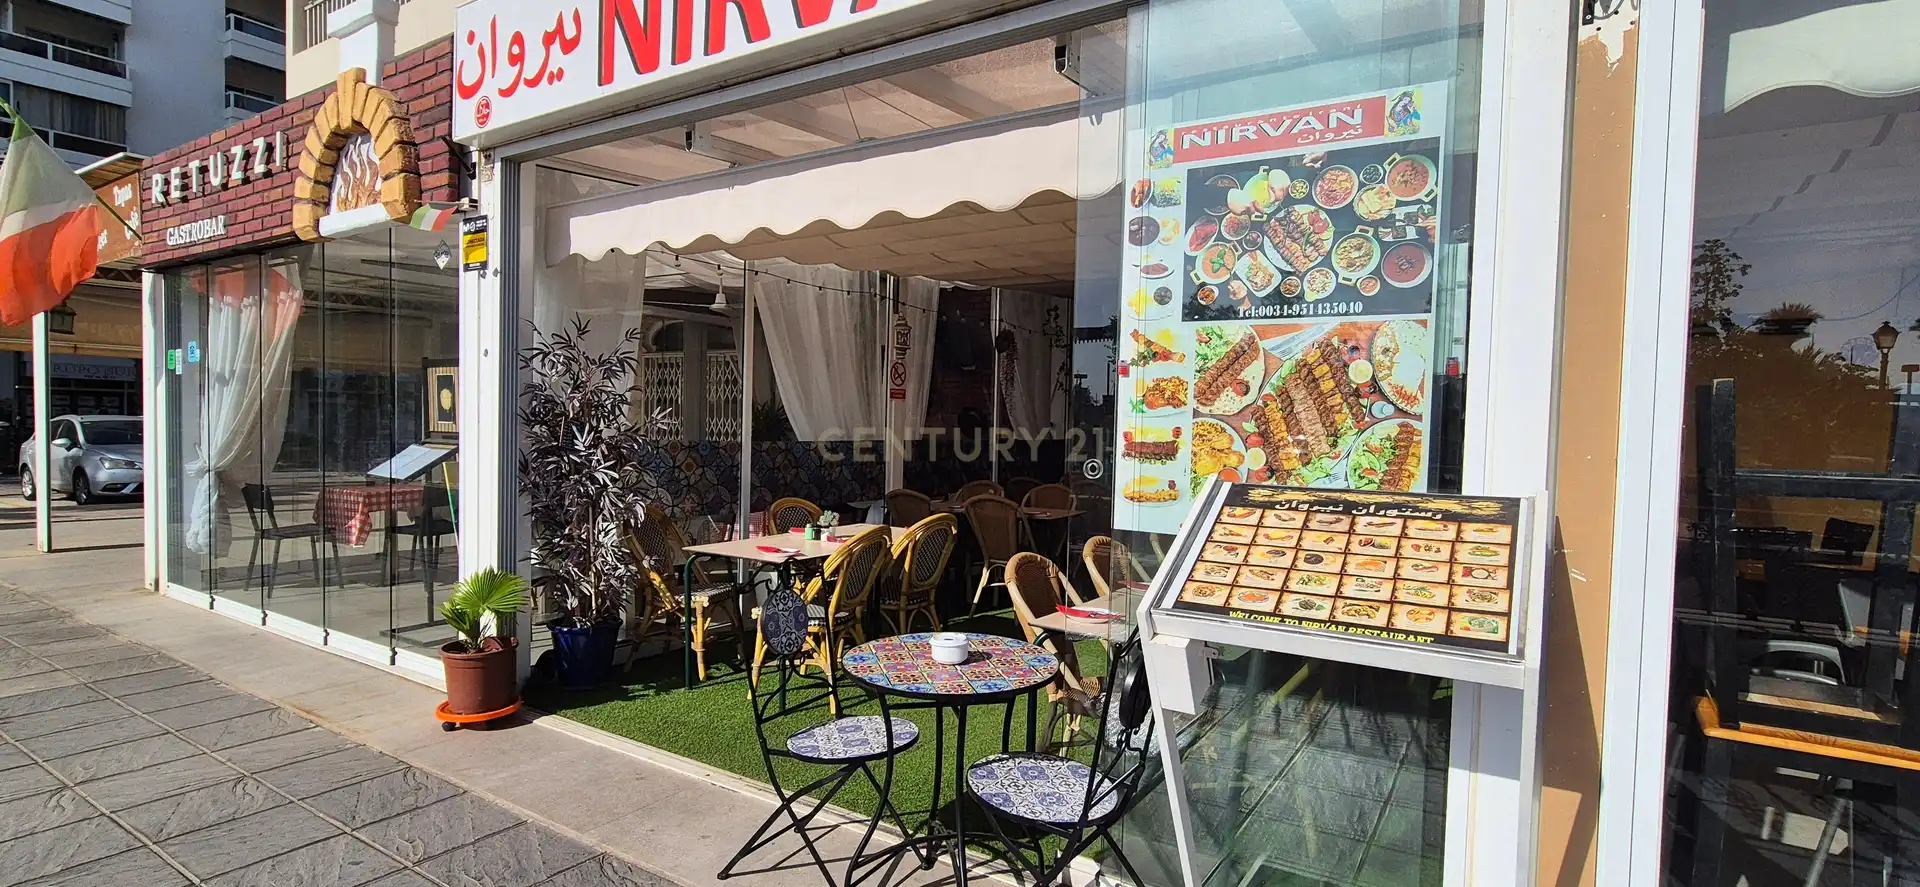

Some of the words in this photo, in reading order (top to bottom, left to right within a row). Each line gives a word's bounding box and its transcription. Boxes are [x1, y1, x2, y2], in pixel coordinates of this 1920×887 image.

[597, 0, 879, 87] NIR
[1180, 107, 1363, 150] NIRVAN
[151, 131, 287, 204] RETUZZI
[166, 215, 227, 246] GASTROBAR
